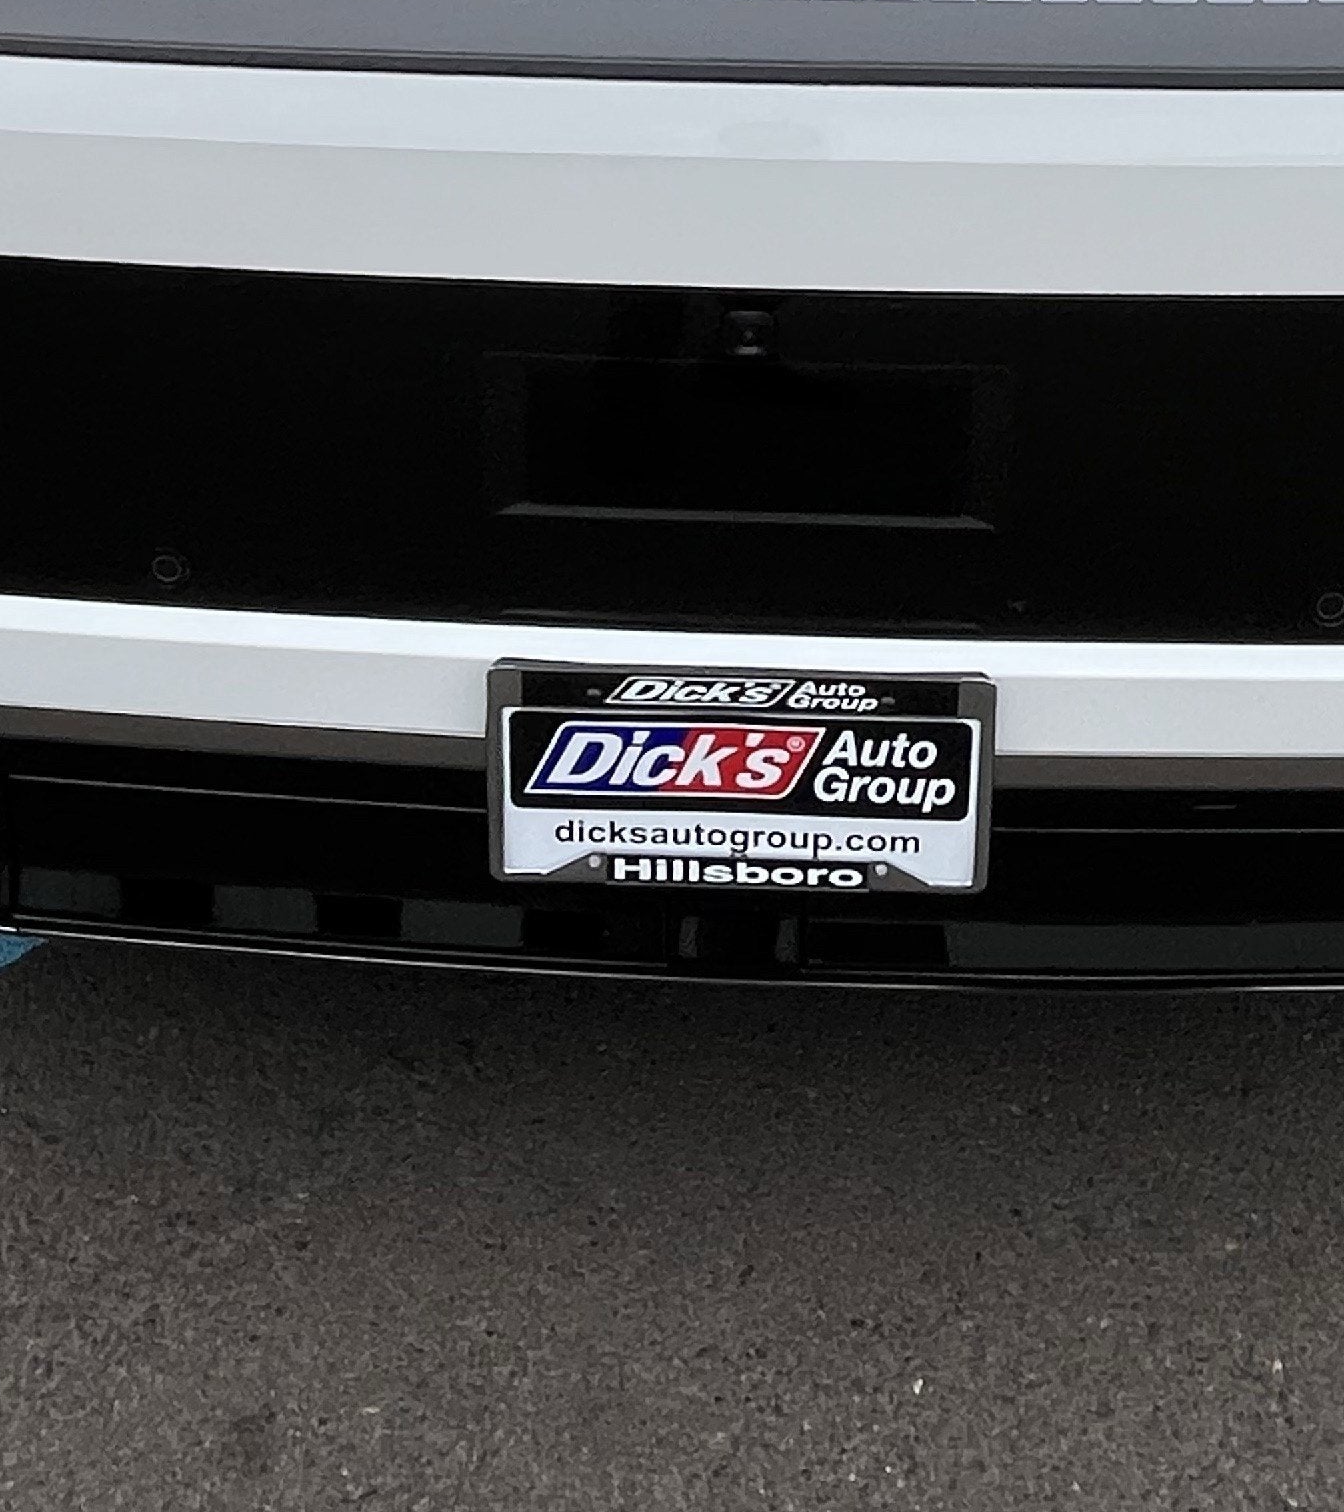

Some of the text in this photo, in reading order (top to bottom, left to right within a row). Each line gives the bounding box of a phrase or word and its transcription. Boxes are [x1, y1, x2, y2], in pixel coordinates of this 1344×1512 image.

[621, 680, 775, 704] Dick's
[787, 694, 878, 713] Group
[800, 681, 866, 698] Auto
[822, 730, 938, 769] Auto
[813, 770, 956, 813] Group
[555, 820, 921, 859] dicksautogroup.com
[613, 858, 864, 887] Hillsboro
